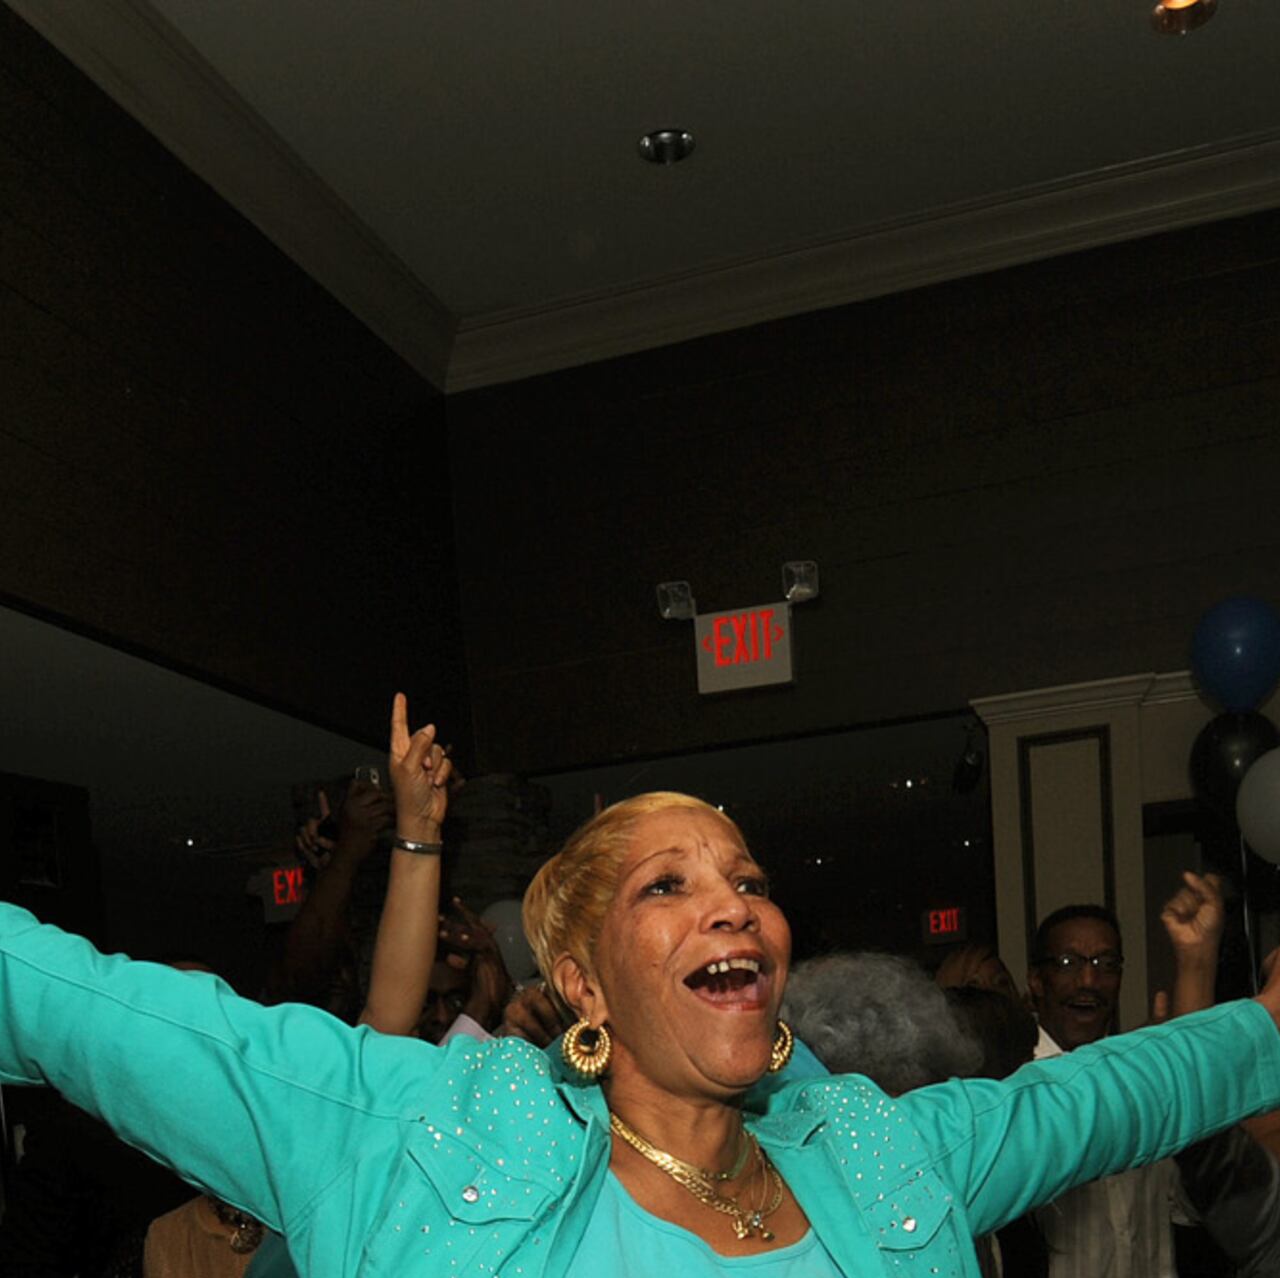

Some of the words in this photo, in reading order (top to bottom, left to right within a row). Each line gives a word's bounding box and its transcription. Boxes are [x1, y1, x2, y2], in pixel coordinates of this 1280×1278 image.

[712, 608, 775, 667] EXIT
[273, 867, 303, 905] EXI
[929, 909, 960, 934] EXIT
